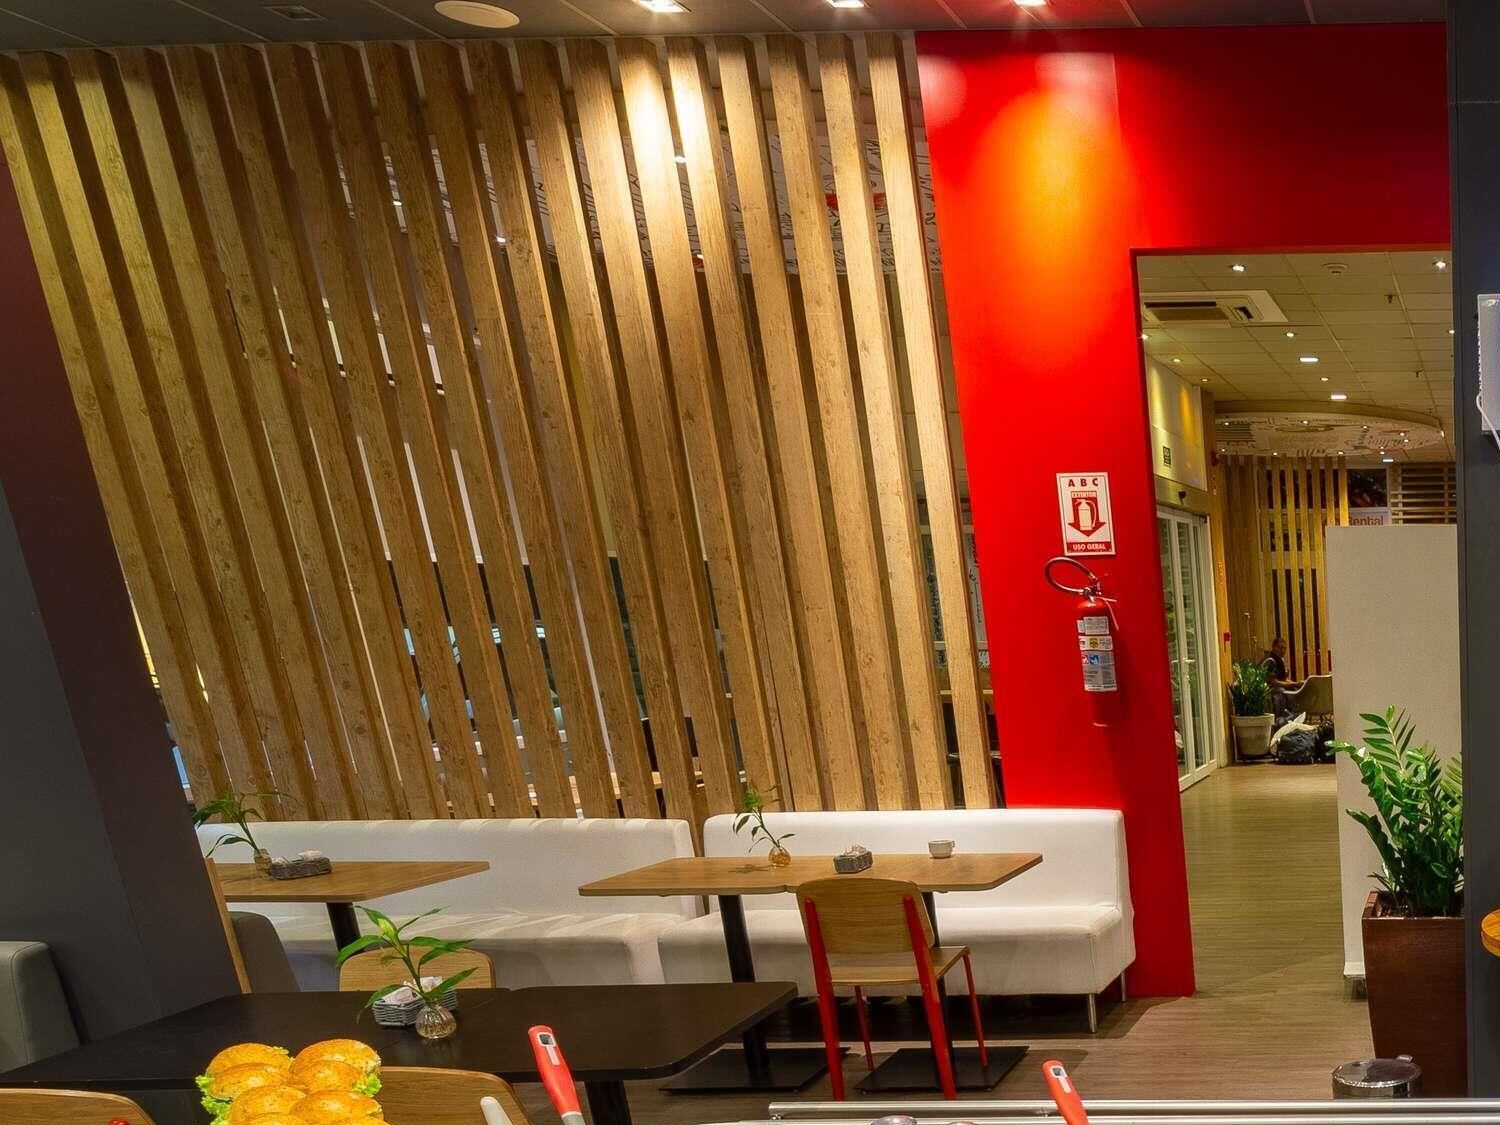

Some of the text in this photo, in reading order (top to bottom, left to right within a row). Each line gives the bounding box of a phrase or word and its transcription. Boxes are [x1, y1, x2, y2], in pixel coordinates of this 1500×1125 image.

[1068, 478, 1099, 487] A B C
[1072, 543, 1086, 551] USO
